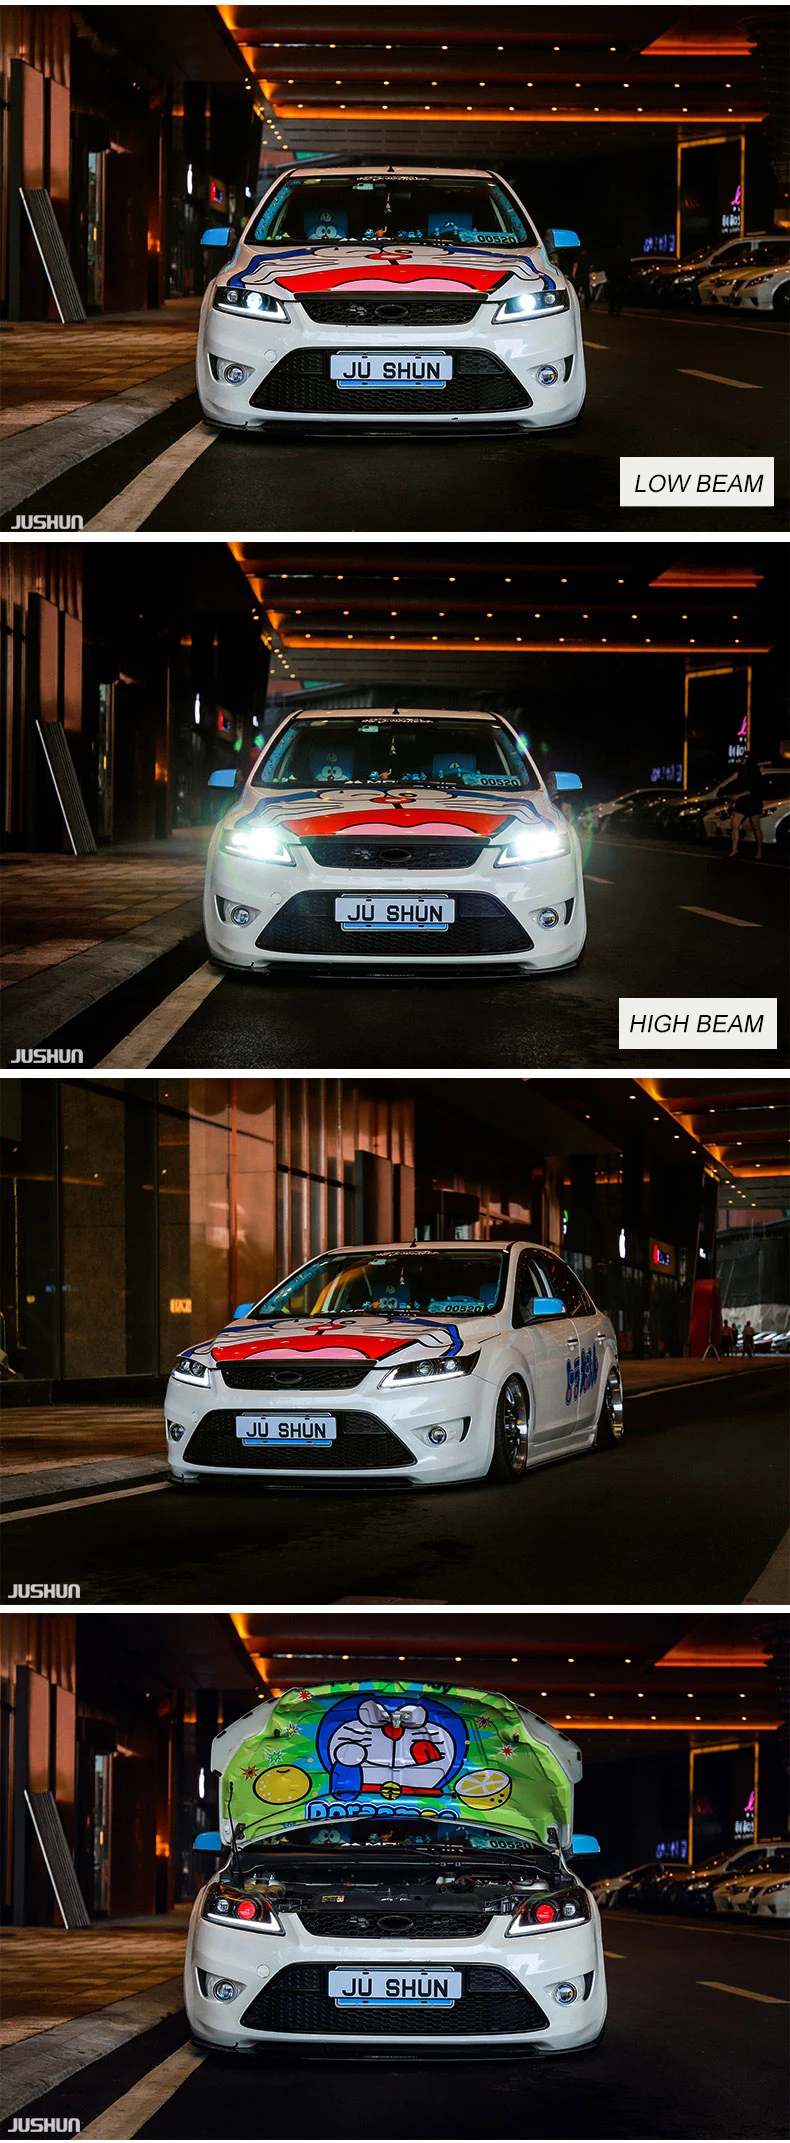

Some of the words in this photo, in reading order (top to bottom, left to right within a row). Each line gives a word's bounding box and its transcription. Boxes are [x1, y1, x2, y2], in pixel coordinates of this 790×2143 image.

[477, 235, 516, 243] 00520
[343, 361, 371, 379] JU
[382, 361, 440, 380] SHUN
[481, 778, 519, 787] 00520
[347, 904, 375, 922] JU
[386, 904, 443, 922] SHUN
[444, 1304, 482, 1313] 00520
[245, 1422, 269, 1438] JU
[278, 1422, 326, 1439] SHUN
[341, 1978, 373, 1997] JU
[385, 1978, 448, 1998] SHUN
